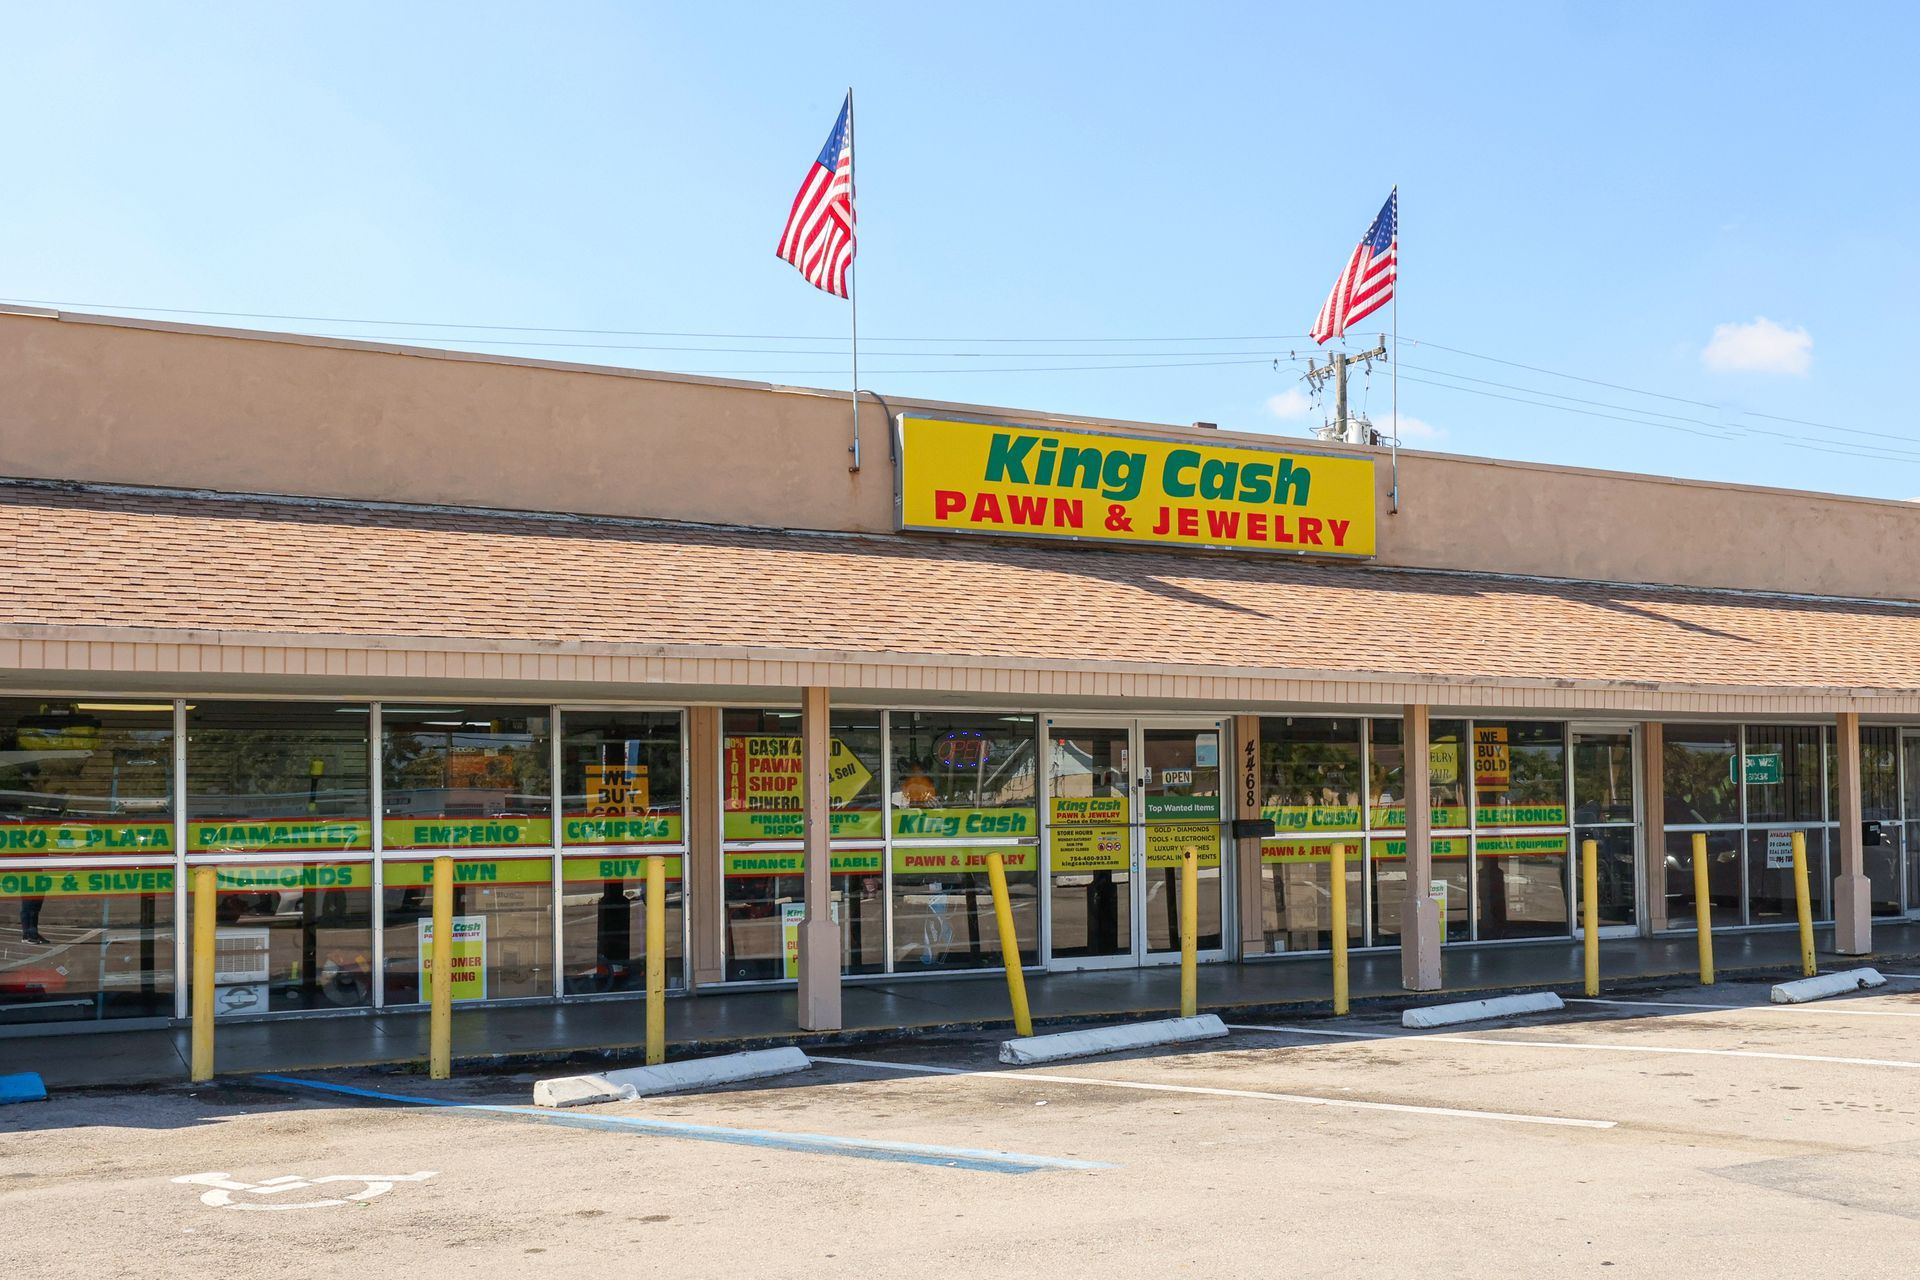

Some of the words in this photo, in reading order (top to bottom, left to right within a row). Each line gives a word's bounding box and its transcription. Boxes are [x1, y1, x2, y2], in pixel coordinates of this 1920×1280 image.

[984, 433, 1147, 501] King
[1162, 450, 1311, 506] Cash
[935, 490, 1083, 528] PAWN
[1104, 504, 1134, 532] &
[1153, 506, 1350, 547] JEWELRY
[1480, 732, 1498, 743] WE
[792, 740, 801, 756] 4
[1478, 746, 1502, 757] BUY
[1430, 752, 1453, 763] ELRY
[749, 758, 802, 773] PAWN
[835, 763, 856, 780] Sell
[1475, 760, 1507, 771] GOLD
[605, 770, 632, 785] WE
[1165, 771, 1190, 783] OPEN
[1245, 739, 1255, 807] 4468
[1429, 768, 1450, 779] PAIR
[749, 776, 797, 791] SHOP
[598, 788, 641, 803] BUY
[749, 796, 800, 809] DINERO
[1057, 801, 1088, 812] King
[1090, 800, 1120, 810] Cash
[1148, 805, 1162, 813] Top
[751, 814, 860, 824] FINANCIENTO
[1262, 809, 1307, 828] King
[1312, 809, 1358, 826] Cash
[1388, 809, 1447, 824] REES
[1476, 809, 1562, 822] ELECTRONICS
[567, 820, 669, 839] COMPRAS
[763, 825, 840, 834] DISPOE
[898, 813, 960, 836] King
[966, 813, 1026, 832] Cash
[57, 829, 74, 848] &
[86, 828, 169, 847] PLATA
[200, 826, 358, 845] DIAMANTES
[414, 821, 519, 843] EMPEÑO
[1261, 847, 1294, 856] PAWN
[1298, 846, 1306, 856] &
[1310, 845, 1359, 855] JEWRY
[1386, 841, 1451, 854] WAES
[1477, 842, 1513, 850] MUSICAL
[1516, 840, 1563, 849] EQUIPMENT
[733, 859, 796, 870] FINANCE
[801, 857, 878, 869] ILABLE
[905, 855, 946, 866] PAWN
[951, 855, 960, 866] &
[965, 854, 1025, 865] JEWLRY
[423, 864, 497, 882] PWN
[600, 860, 640, 877] BUY
[0, 875, 52, 893] OLD
[61, 874, 79, 892] &
[88, 872, 173, 891] SILVER
[453, 923, 481, 932] Cash
[424, 957, 482, 969] COMER
[430, 972, 476, 984] KING
